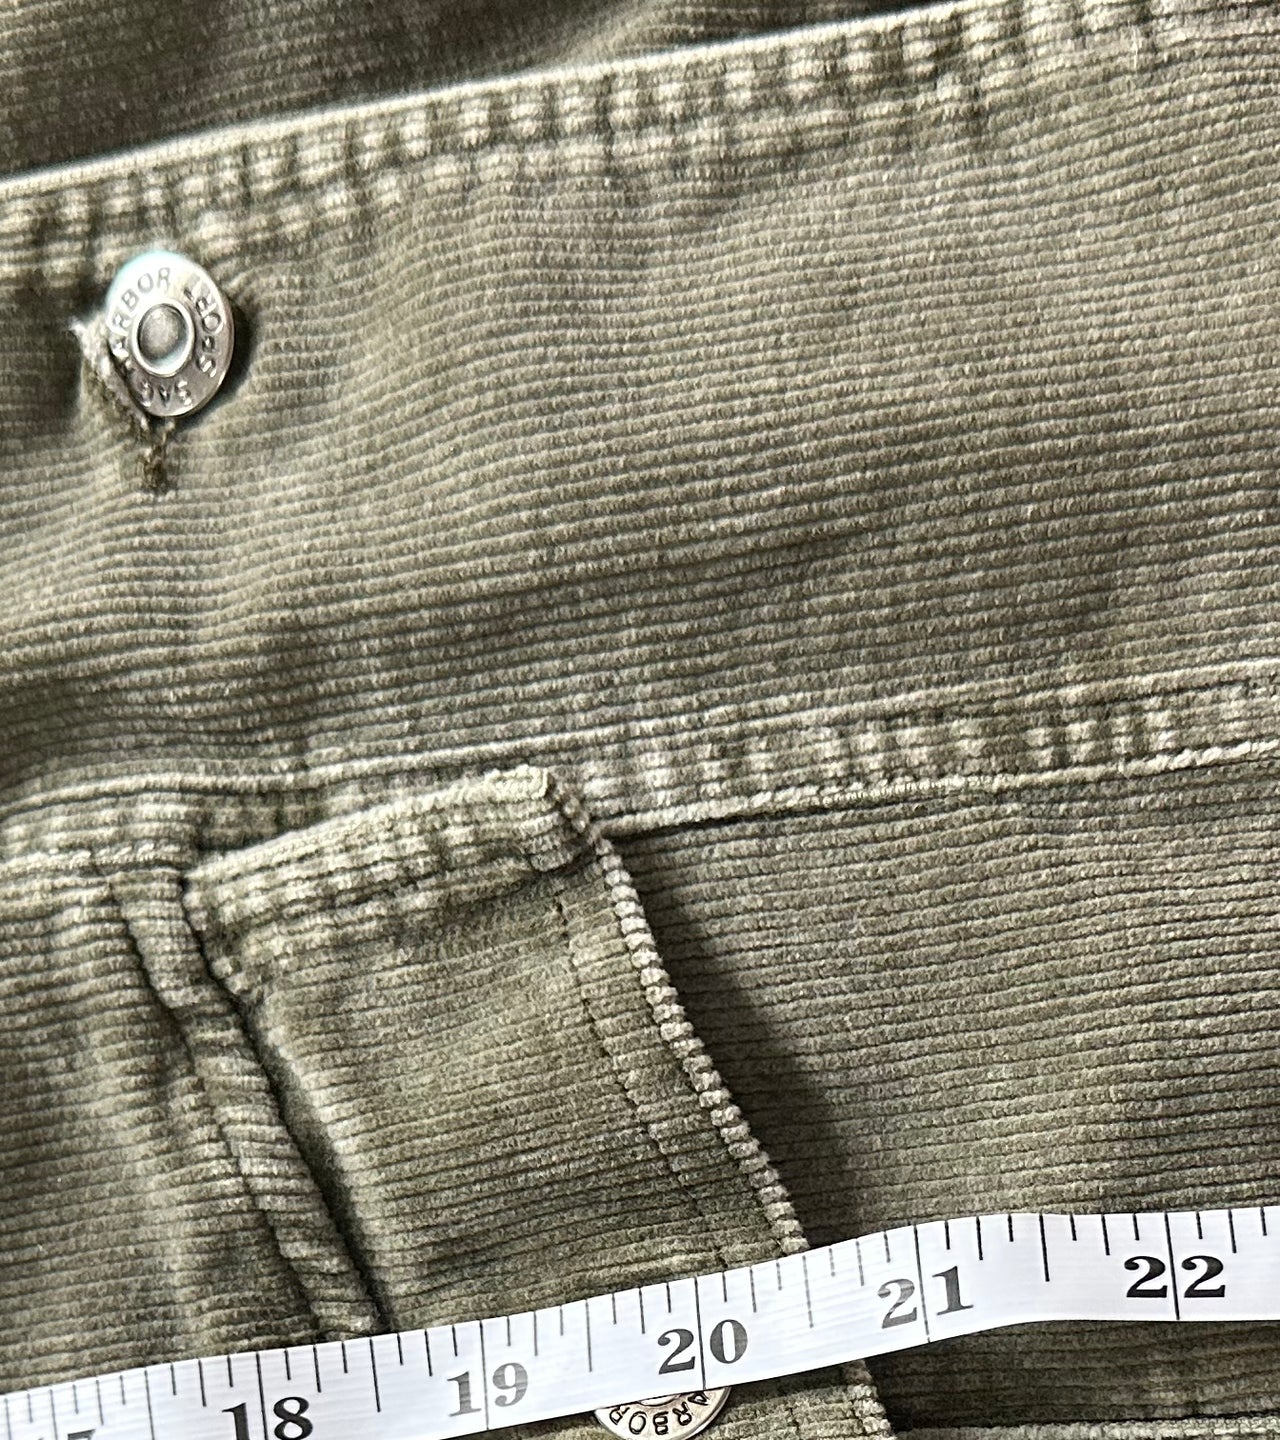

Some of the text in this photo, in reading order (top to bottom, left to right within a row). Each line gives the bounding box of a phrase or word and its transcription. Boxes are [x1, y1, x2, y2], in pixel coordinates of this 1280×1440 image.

[447, 1361, 529, 1419] 19
[657, 1318, 749, 1375] 20
[877, 1265, 975, 1331] 21
[1123, 1255, 1227, 1299] 22
[609, 1391, 711, 1436] ARBOR
